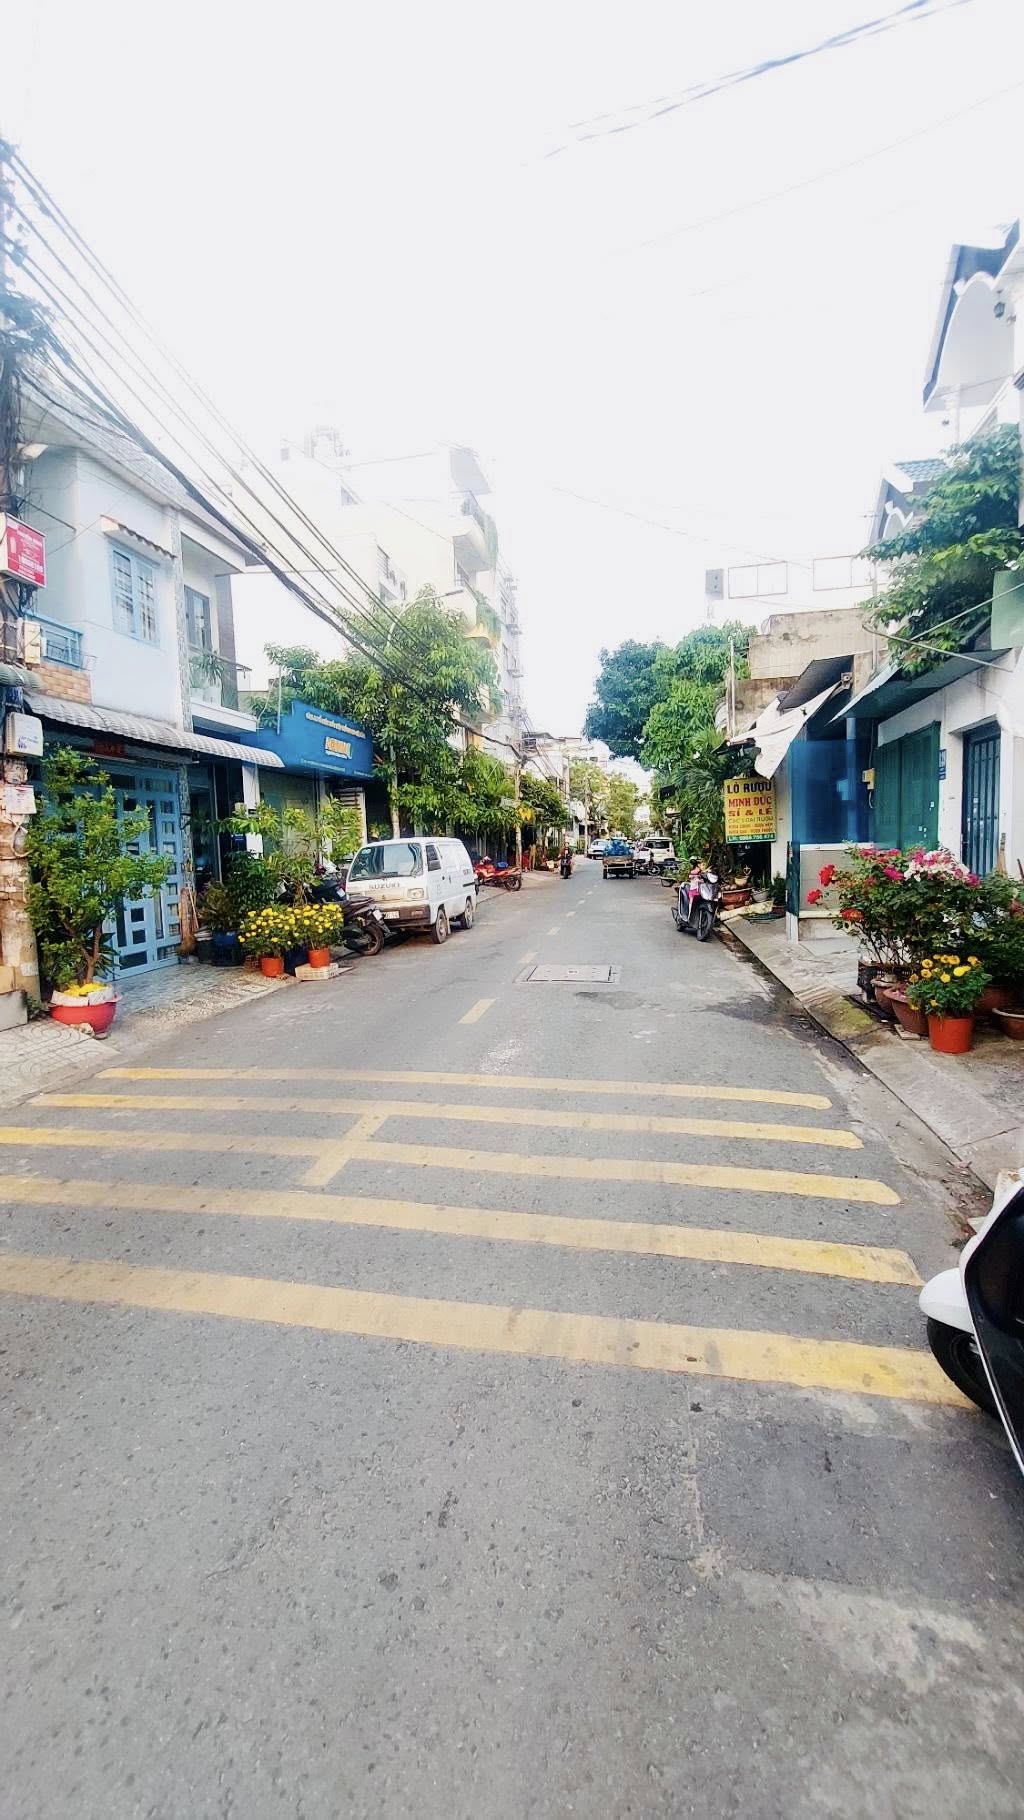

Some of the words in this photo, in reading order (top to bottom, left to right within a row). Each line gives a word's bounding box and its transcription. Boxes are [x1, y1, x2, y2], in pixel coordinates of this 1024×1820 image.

[744, 782, 771, 794] RƯỢU
[729, 798, 750, 807] MINH
[754, 796, 771, 805] ĐỨC
